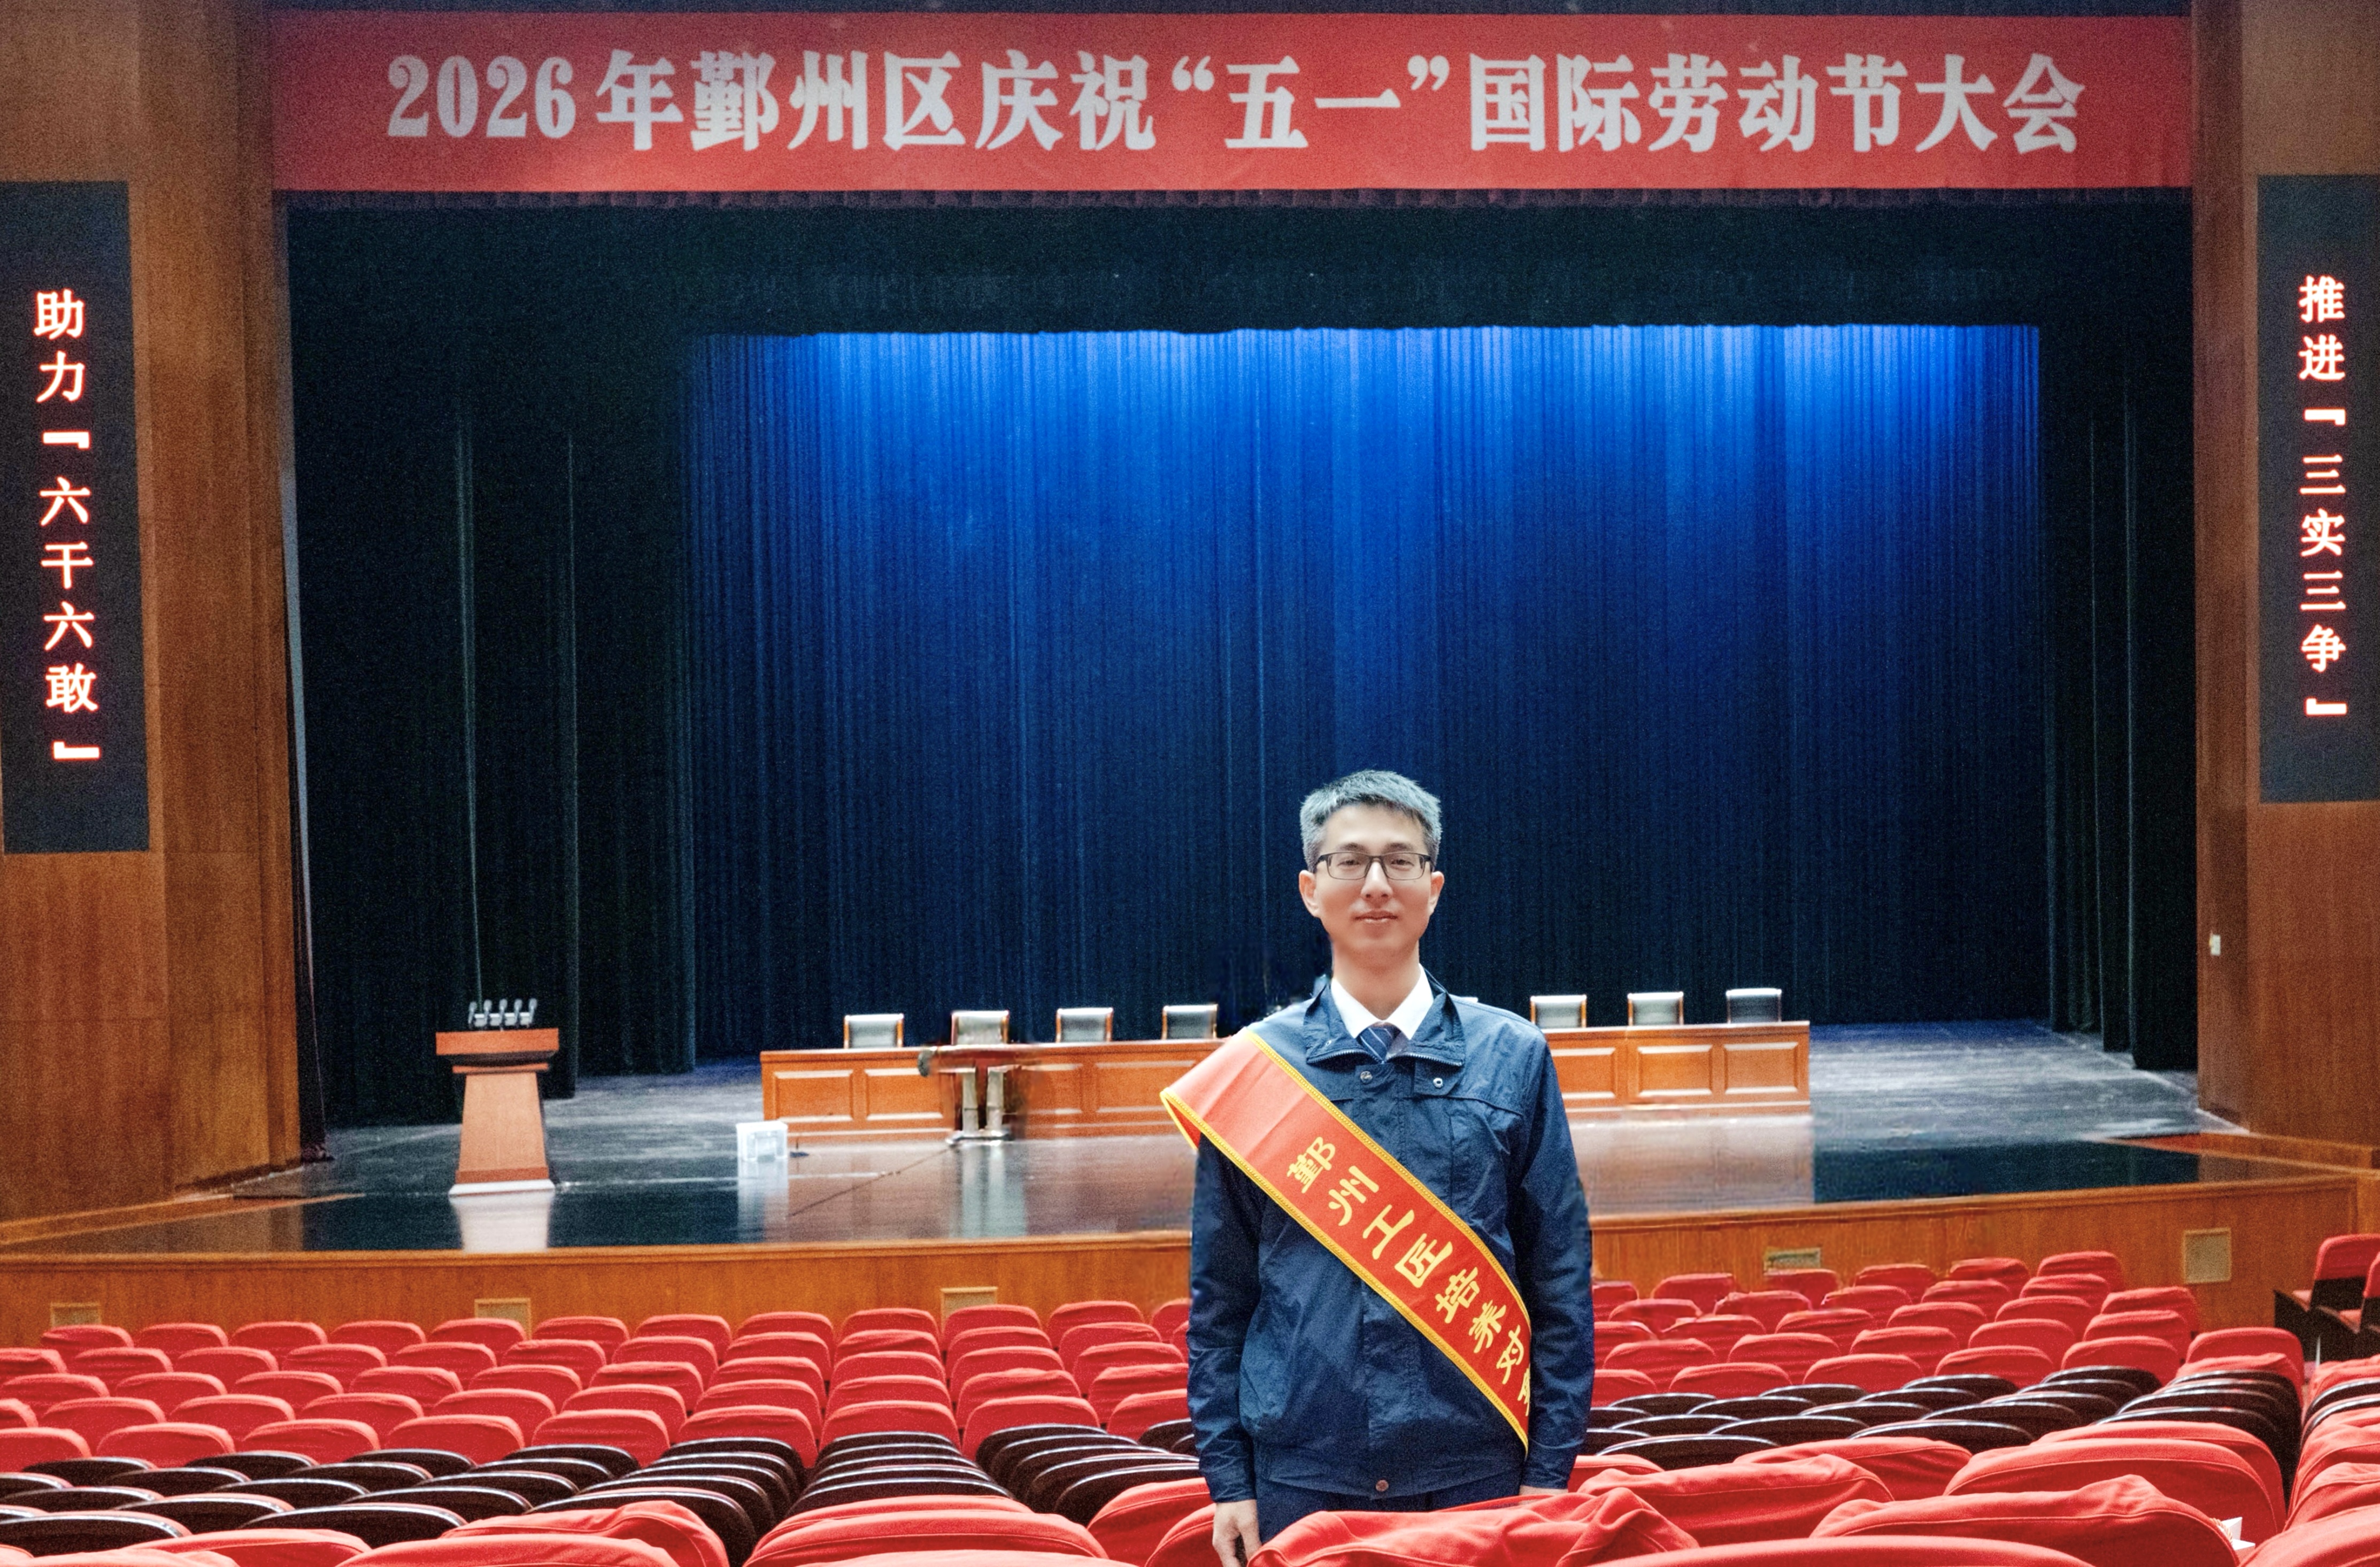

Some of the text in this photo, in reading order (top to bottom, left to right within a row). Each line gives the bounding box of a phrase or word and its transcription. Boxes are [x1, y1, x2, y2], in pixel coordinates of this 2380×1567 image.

[388, 49, 2085, 154] 2026年鄞州区庆祝“五一”国际劳动节大会
